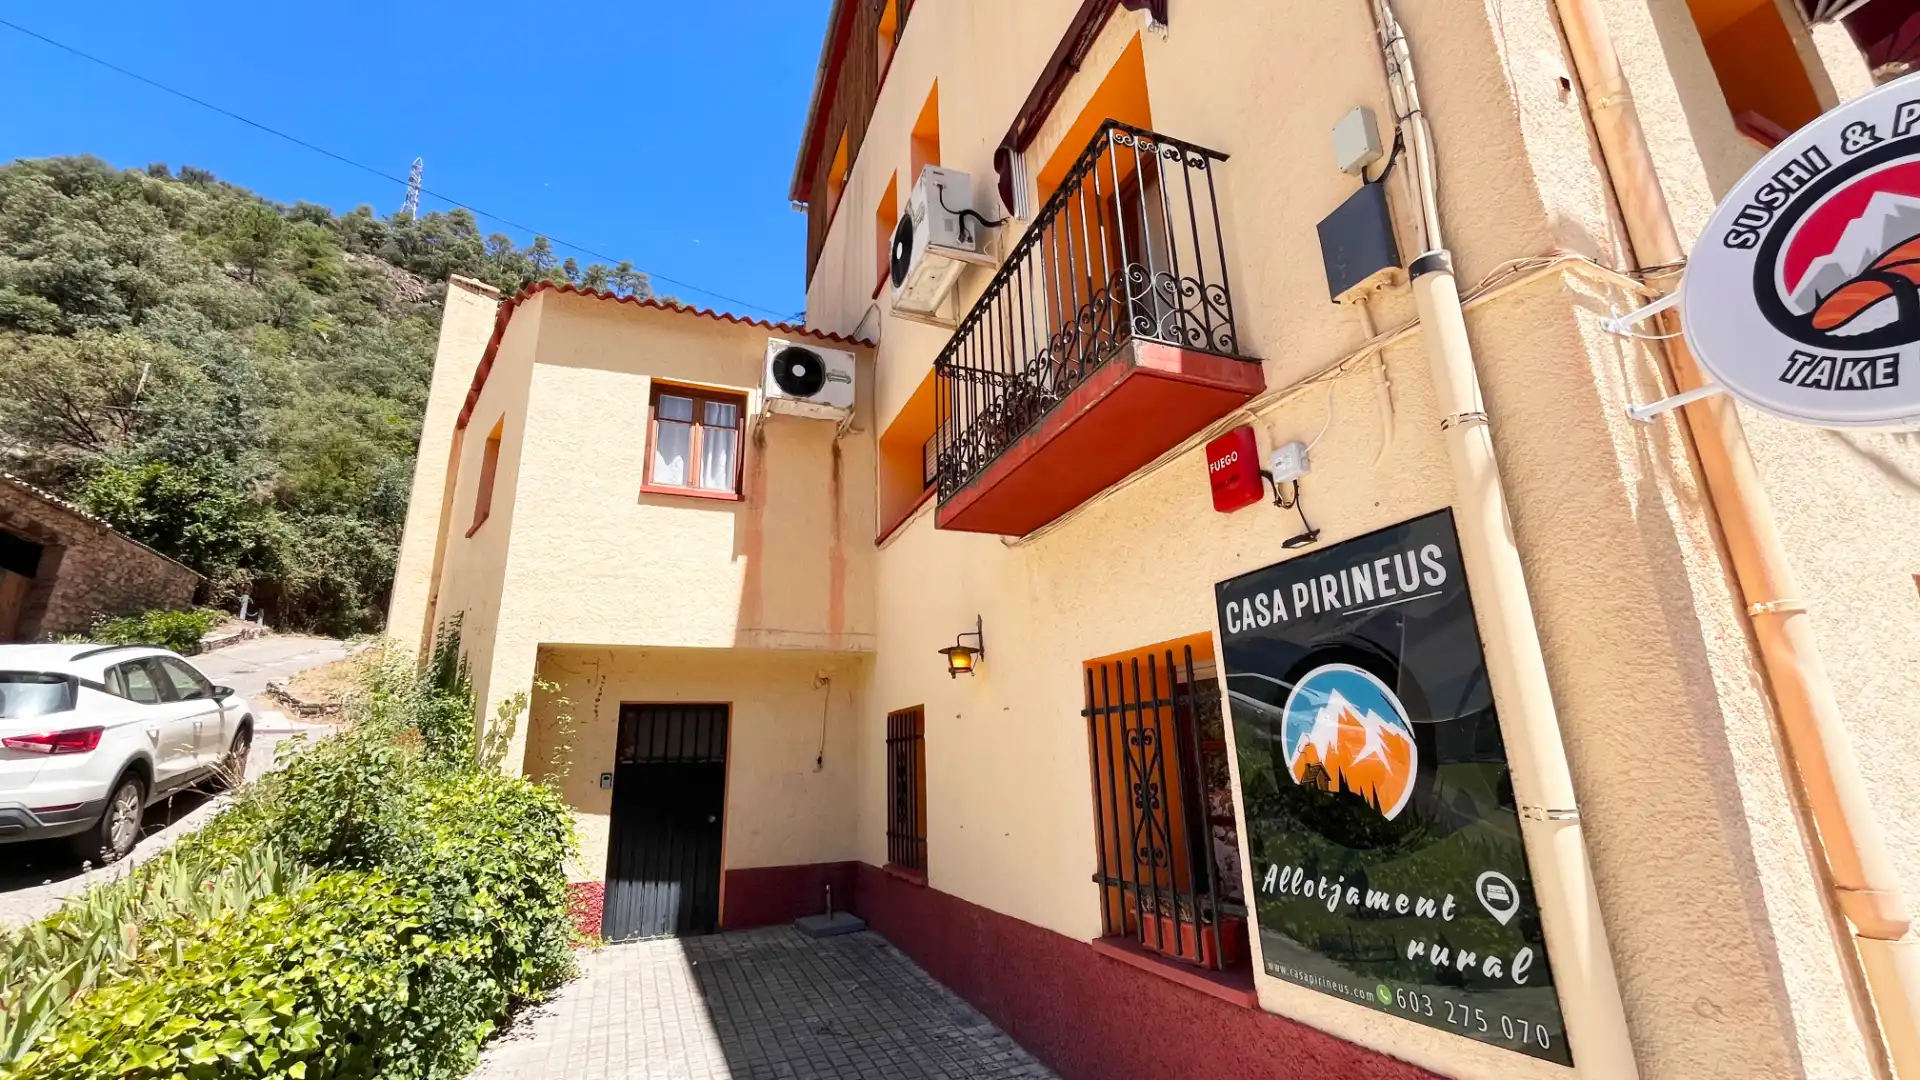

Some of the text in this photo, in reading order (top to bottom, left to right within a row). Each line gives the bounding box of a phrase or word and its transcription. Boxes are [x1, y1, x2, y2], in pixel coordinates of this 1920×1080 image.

[1723, 145, 1832, 249] SUSHI
[1841, 121, 1885, 155] &
[1779, 350, 1899, 391] TAKE
[1209, 451, 1238, 474] FUEGO
[1226, 544, 1447, 634] CASA PIRINEUS
[1261, 863, 1457, 922] Allotjament
[1268, 962, 1375, 1002] www.casapirineus.com
[1407, 939, 1534, 985] rural
[1396, 987, 1550, 1050] 603 275 070
